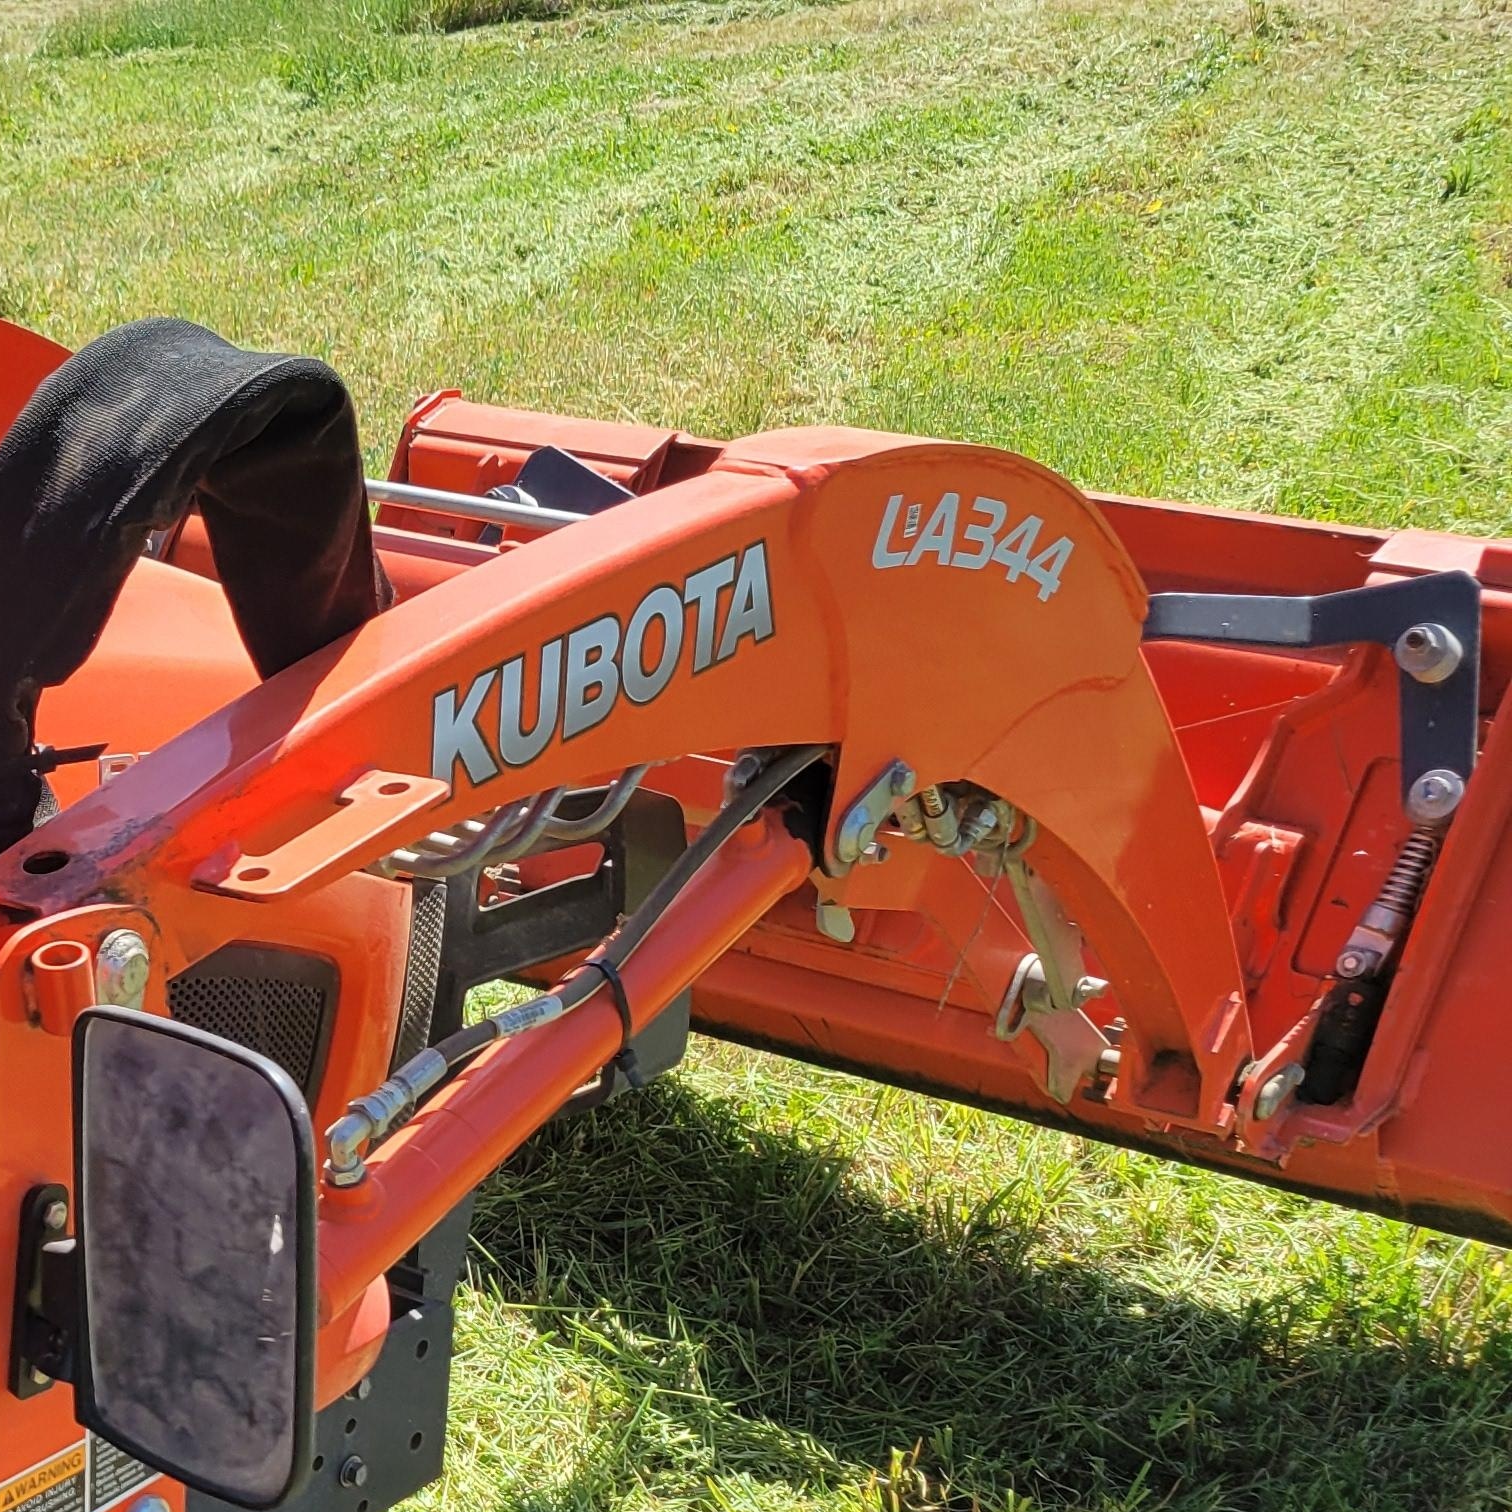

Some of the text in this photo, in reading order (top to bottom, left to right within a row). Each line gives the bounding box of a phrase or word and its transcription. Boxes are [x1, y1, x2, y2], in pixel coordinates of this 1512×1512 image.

[872, 492, 1075, 602] LA344
[431, 538, 775, 792] KUBOTA
[13, 1453, 82, 1497] WARNING
